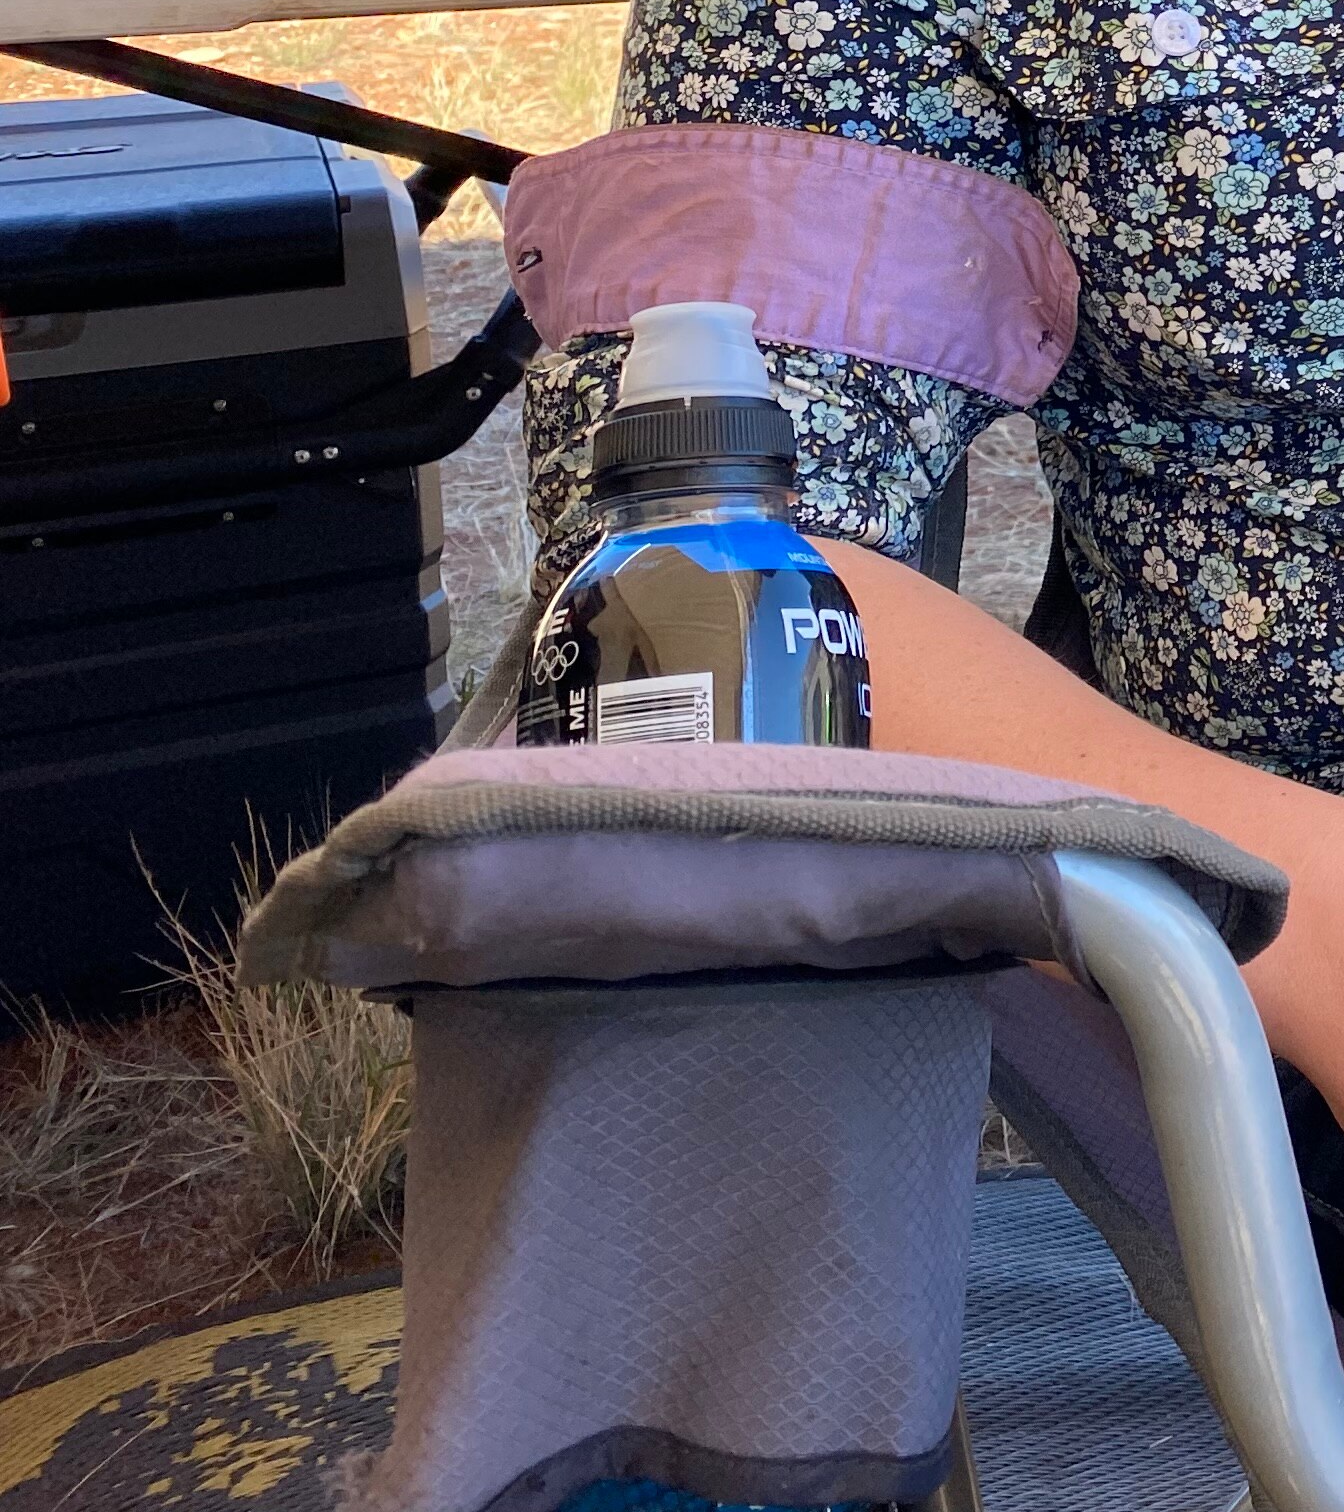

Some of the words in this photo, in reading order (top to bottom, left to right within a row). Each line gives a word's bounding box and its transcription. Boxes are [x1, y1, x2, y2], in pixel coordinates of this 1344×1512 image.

[780, 607, 870, 659] POW
[569, 687, 586, 731] ME
[696, 690, 710, 745] 08354
